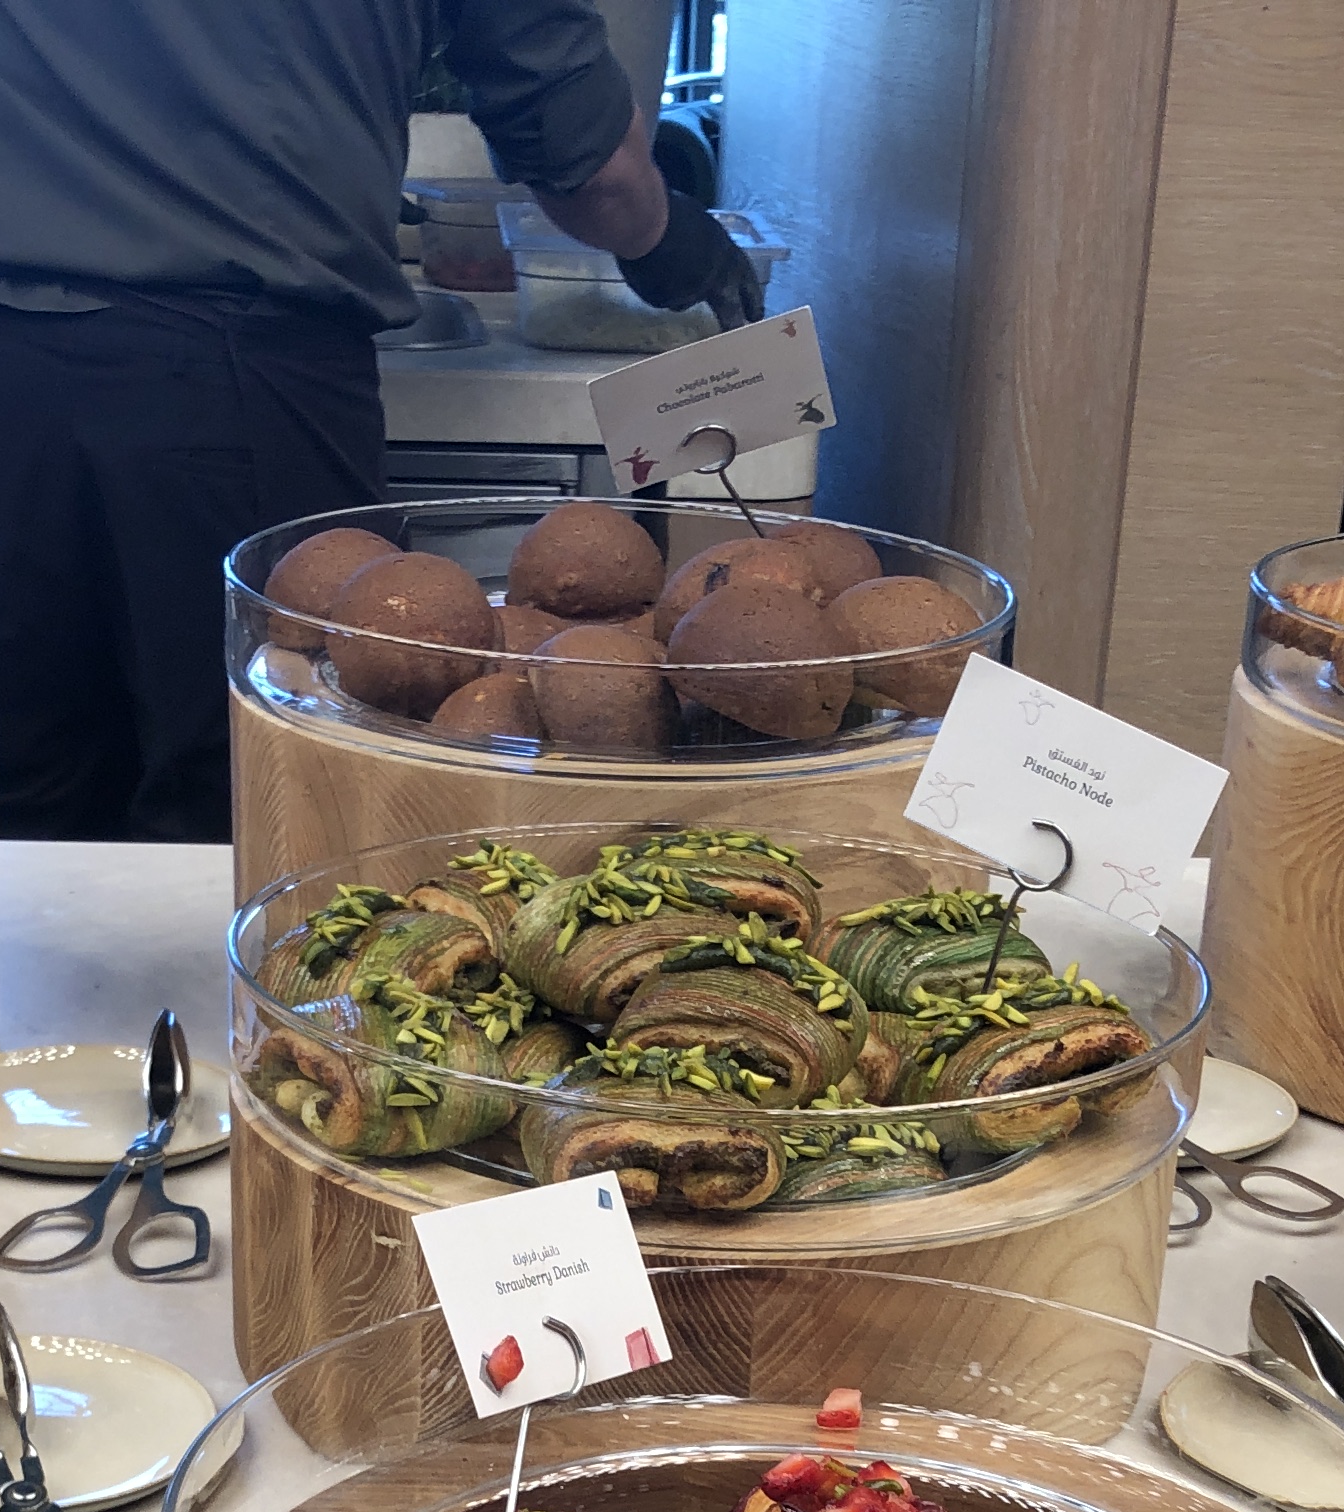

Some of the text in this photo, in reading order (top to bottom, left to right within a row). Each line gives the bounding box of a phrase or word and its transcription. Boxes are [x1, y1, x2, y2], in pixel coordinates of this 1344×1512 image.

[657, 391, 710, 414] Chocolate
[1047, 748, 1088, 773] الفستق
[1022, 755, 1114, 808] Pistacho Node
[512, 1249, 538, 1267] فراولة
[495, 1257, 591, 1296] Strawberry Danish
